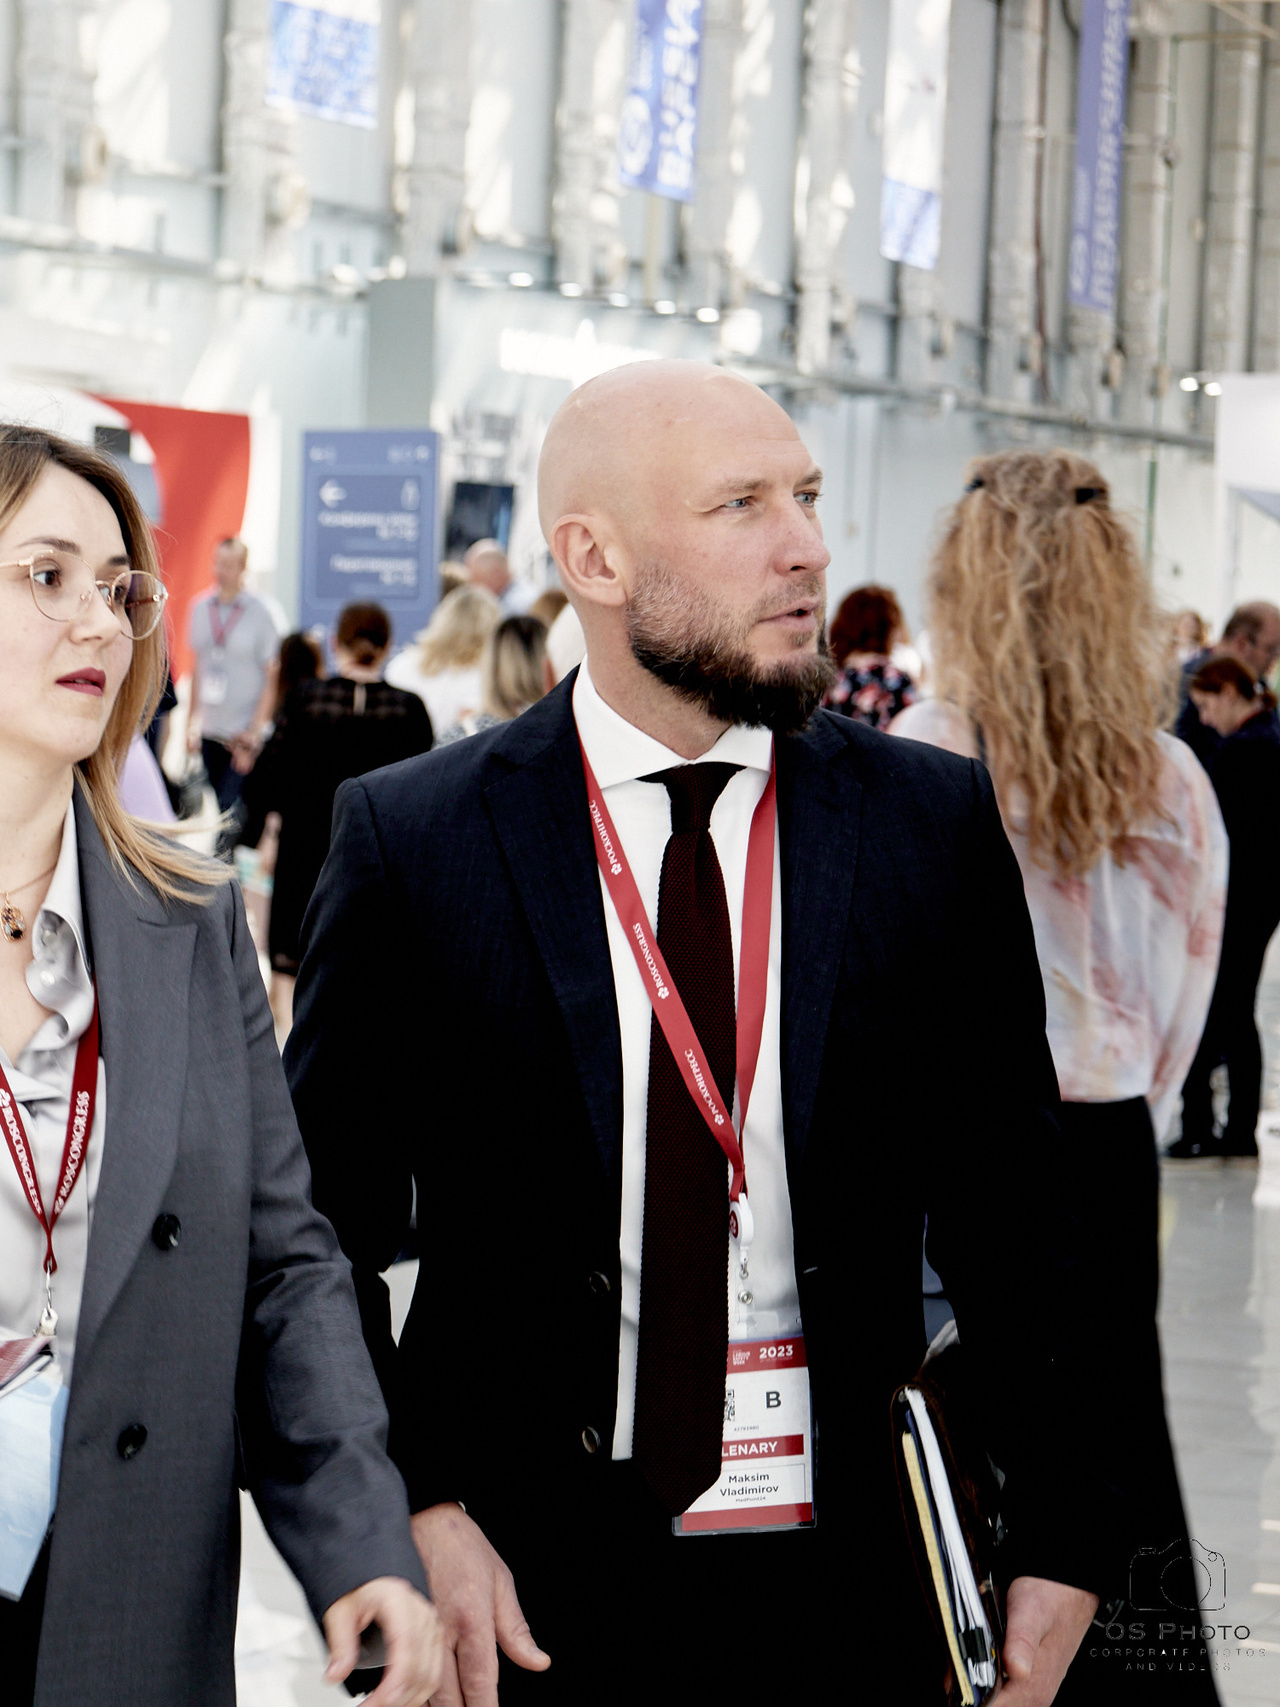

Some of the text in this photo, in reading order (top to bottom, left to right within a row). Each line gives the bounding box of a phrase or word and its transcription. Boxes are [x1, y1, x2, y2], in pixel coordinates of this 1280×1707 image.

[589, 800, 618, 865] РОСКОНГРЕСС
[632, 922, 665, 989] ROSCONGRESS
[684, 1048, 719, 1116] РОСКОНГРЕСС
[1, 1105, 42, 1215] ROSCONGRESS
[59, 1091, 90, 1198] ROSCONGRESS
[759, 1344, 793, 1359] 2023
[765, 1390, 782, 1409] B
[722, 1441, 778, 1457] LENARY
[720, 1485, 779, 1497] Vladimirov
[728, 1473, 770, 1484] Maksim
